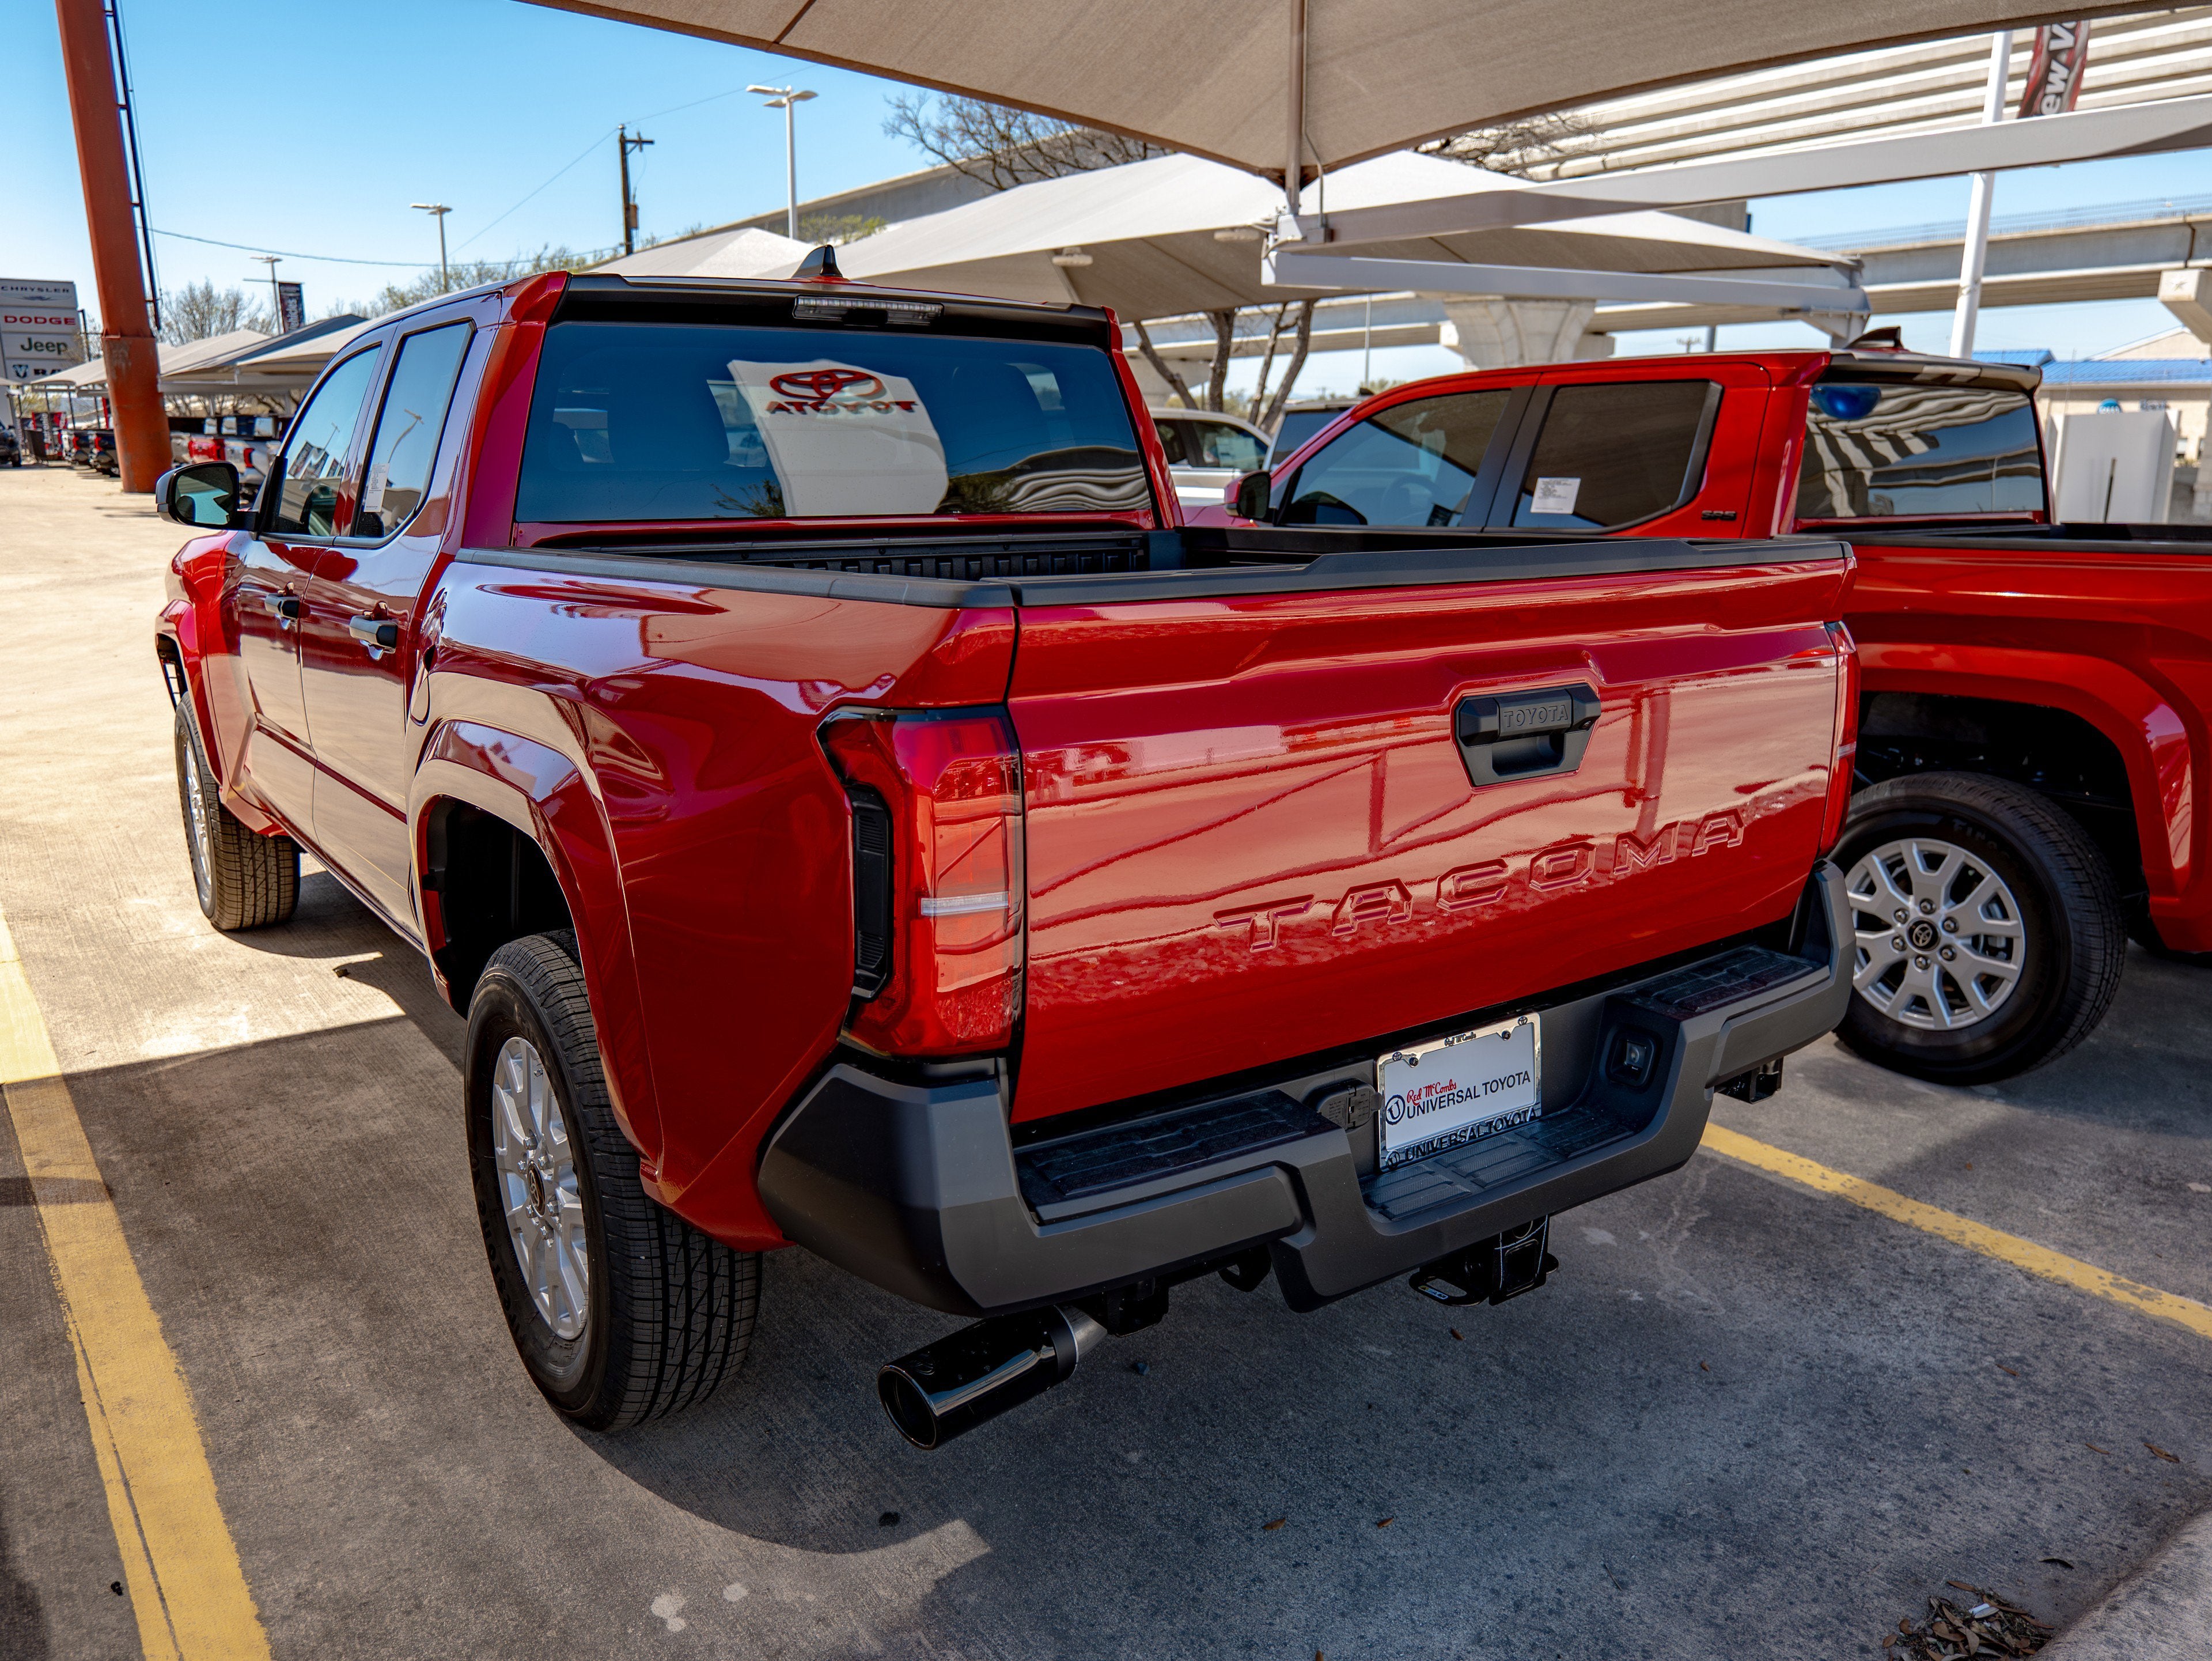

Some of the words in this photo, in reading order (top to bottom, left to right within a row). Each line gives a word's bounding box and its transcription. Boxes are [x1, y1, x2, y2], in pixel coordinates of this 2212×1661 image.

[2040, 59, 2070, 115] ew
[4, 315, 76, 326] DODGE
[20, 337, 68, 355] Jeep
[1503, 705, 1569, 728] TOYOTA
[1213, 808, 1745, 954] TACOMA
[1407, 1087, 1422, 1106] Red
[1423, 1079, 1457, 1098] McCombs
[1407, 1085, 1481, 1119] UNIVERSAL
[1482, 1070, 1531, 1096] TOYOTA
[1404, 1123, 1484, 1162] UNIVERSAL
[1485, 1106, 1537, 1133] TOYOTA
